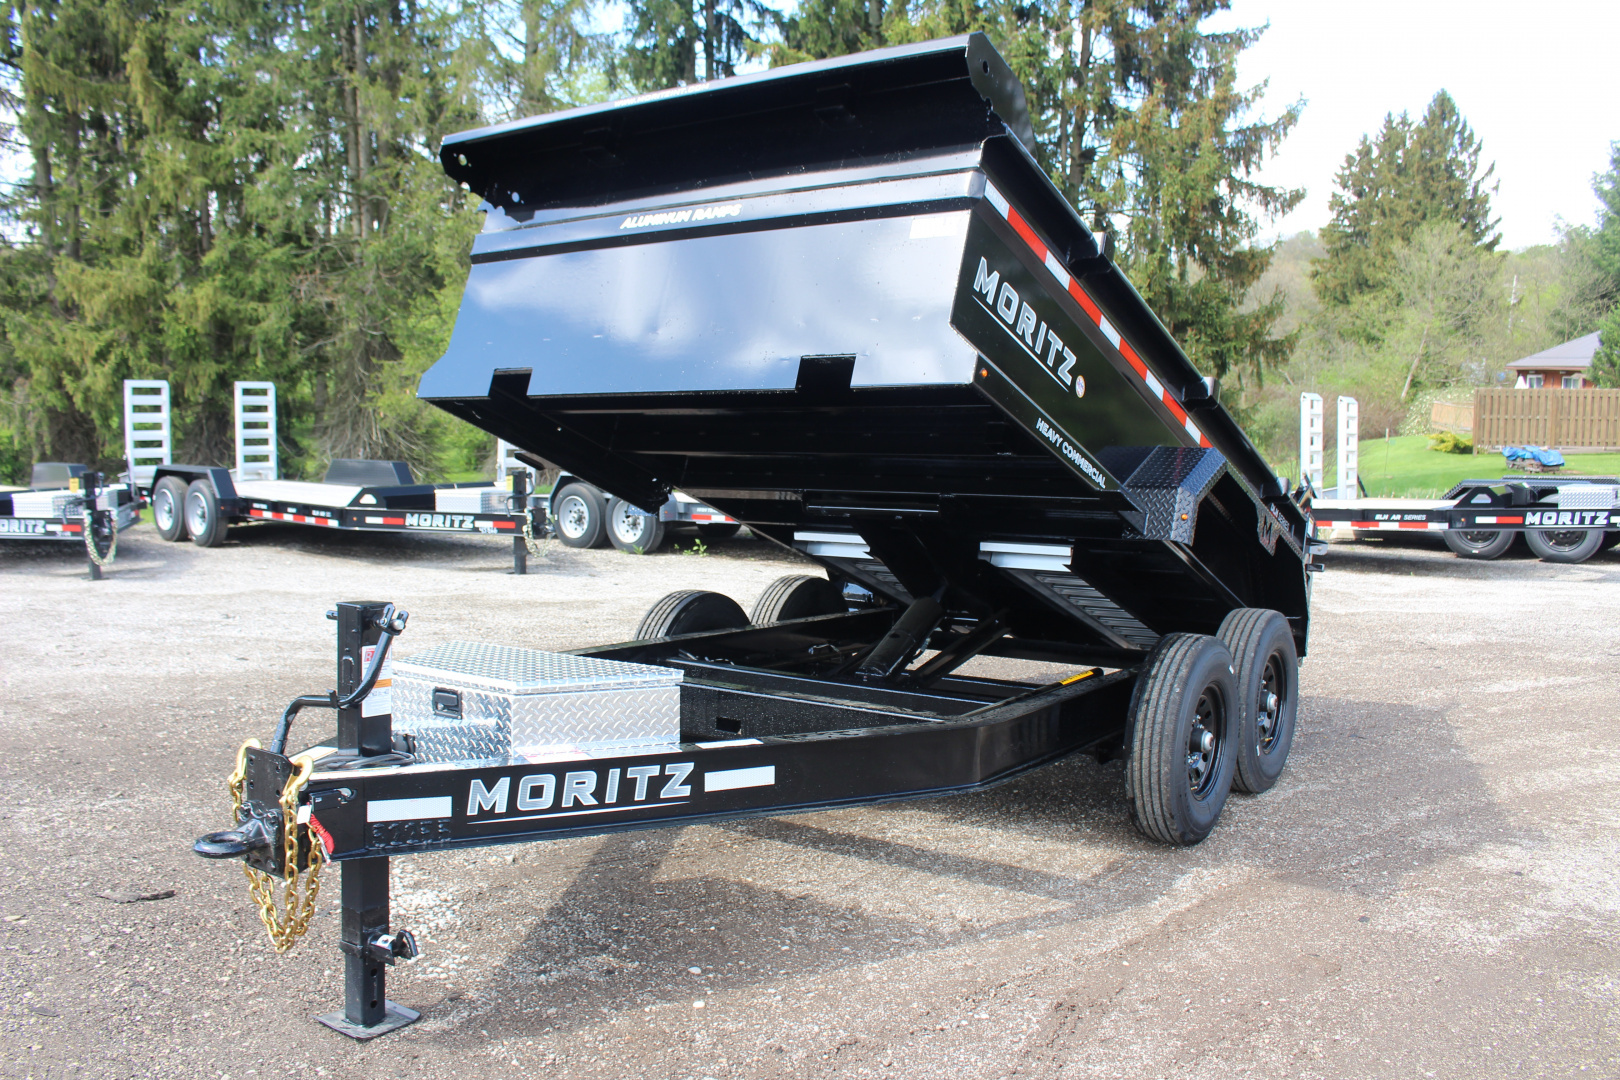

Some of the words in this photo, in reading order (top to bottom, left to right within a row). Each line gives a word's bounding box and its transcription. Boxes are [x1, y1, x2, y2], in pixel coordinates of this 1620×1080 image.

[620, 209, 692, 229] ALUMINUM
[692, 203, 742, 221] RAMPS
[973, 256, 1077, 386] MORITZ
[1036, 417, 1063, 448] HEAVY
[1062, 441, 1106, 489] COMMERCIAL
[405, 513, 475, 529] MORITZ
[1525, 511, 1609, 525] MORITZ
[467, 762, 695, 816] MORITZ
